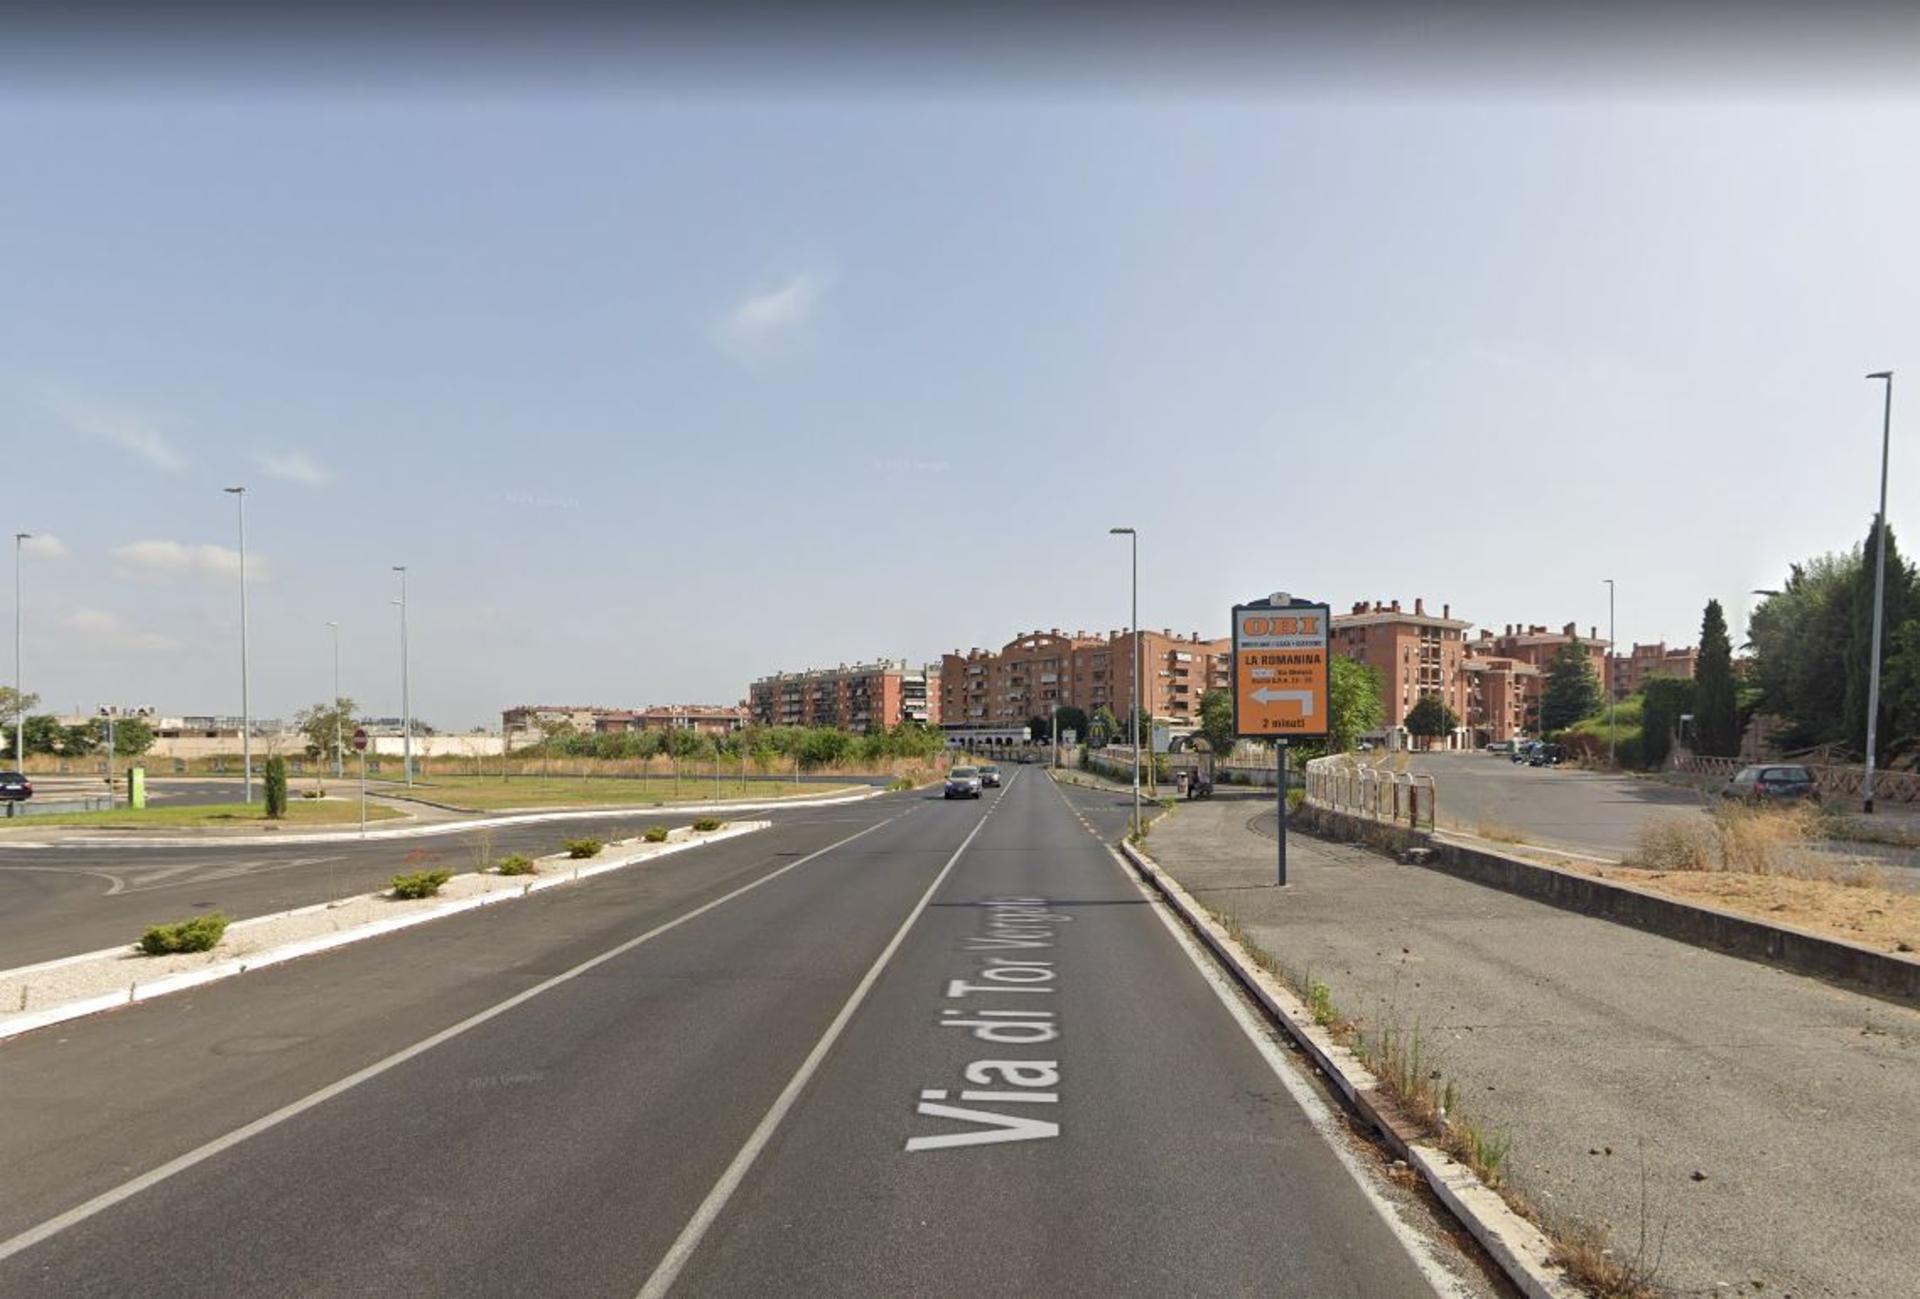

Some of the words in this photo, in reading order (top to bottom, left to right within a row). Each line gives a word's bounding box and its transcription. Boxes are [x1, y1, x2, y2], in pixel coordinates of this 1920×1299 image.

[1243, 616, 1320, 636] OBI
[1244, 655, 1258, 666] LA
[1261, 654, 1321, 666] ROMANINA
[1262, 718, 1270, 728] 2
[1271, 718, 1305, 728] minuti
